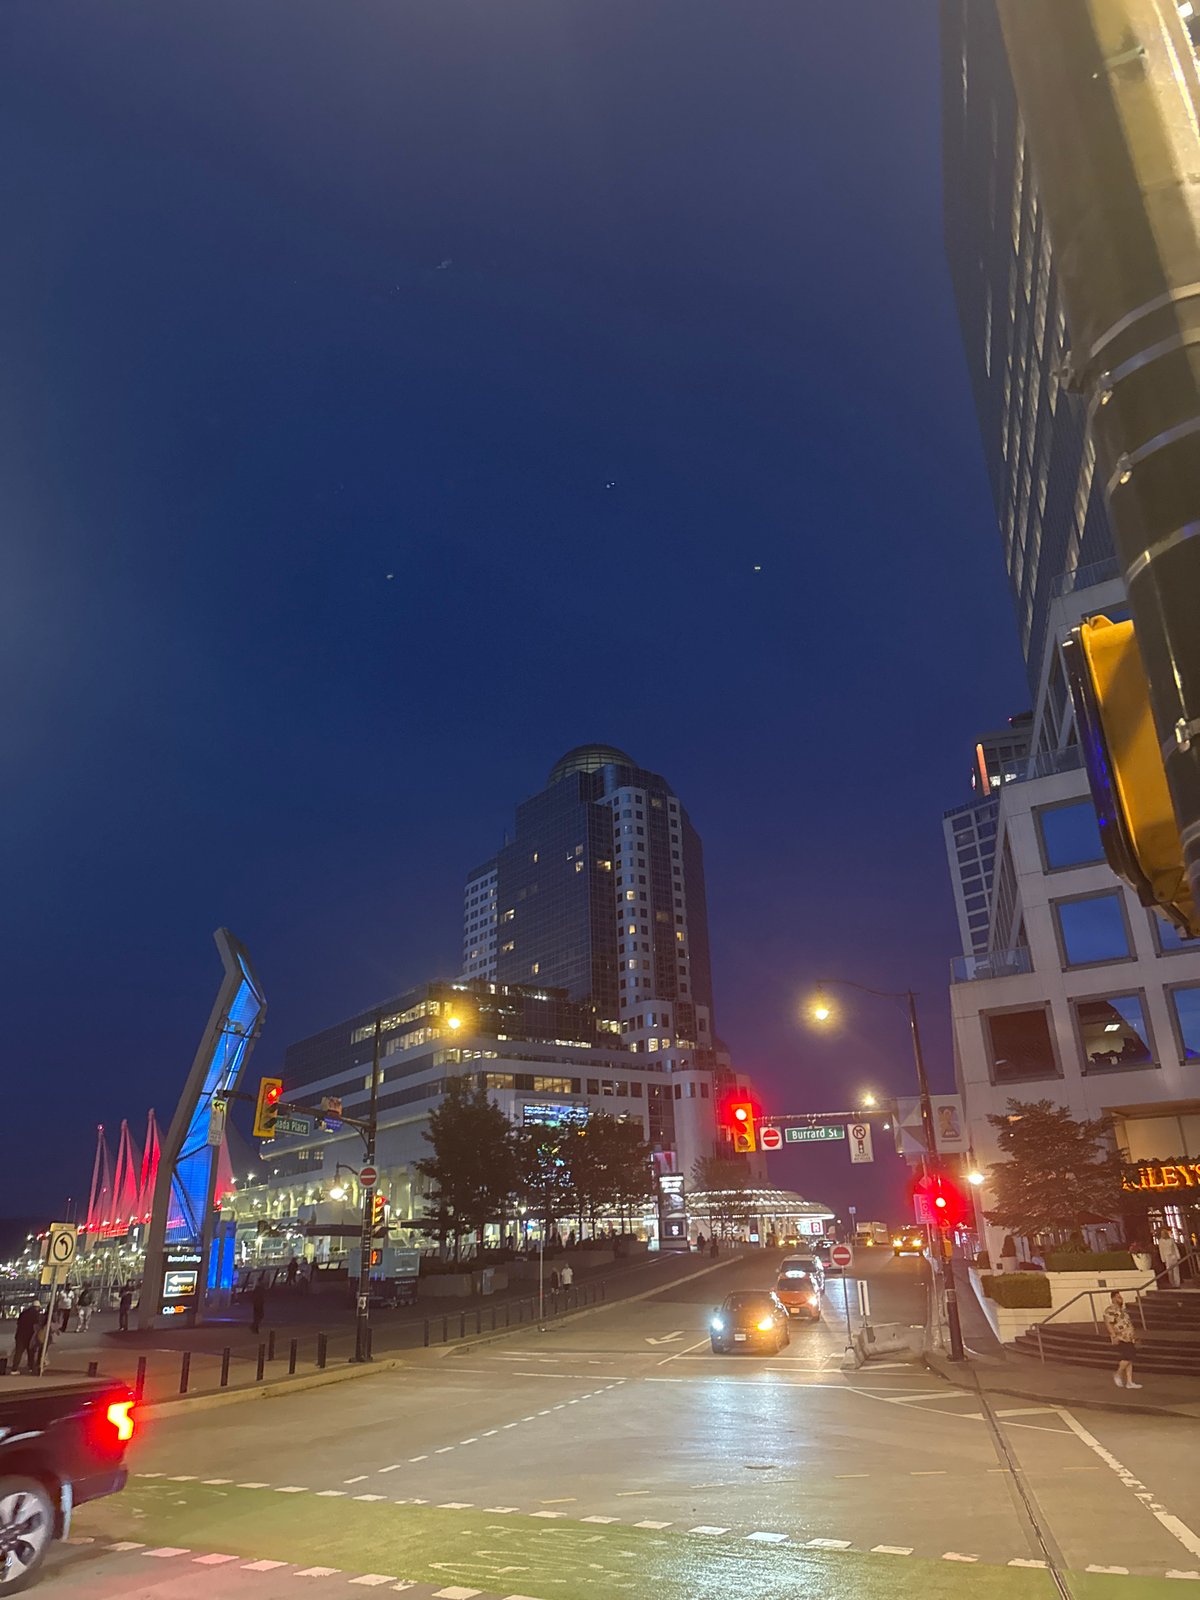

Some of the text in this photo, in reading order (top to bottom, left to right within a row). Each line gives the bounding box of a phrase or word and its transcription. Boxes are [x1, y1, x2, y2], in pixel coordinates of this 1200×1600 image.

[276, 1119, 307, 1133] nada Place
[792, 1127, 838, 1139] Burrard St
[168, 1284, 193, 1292] Parking
